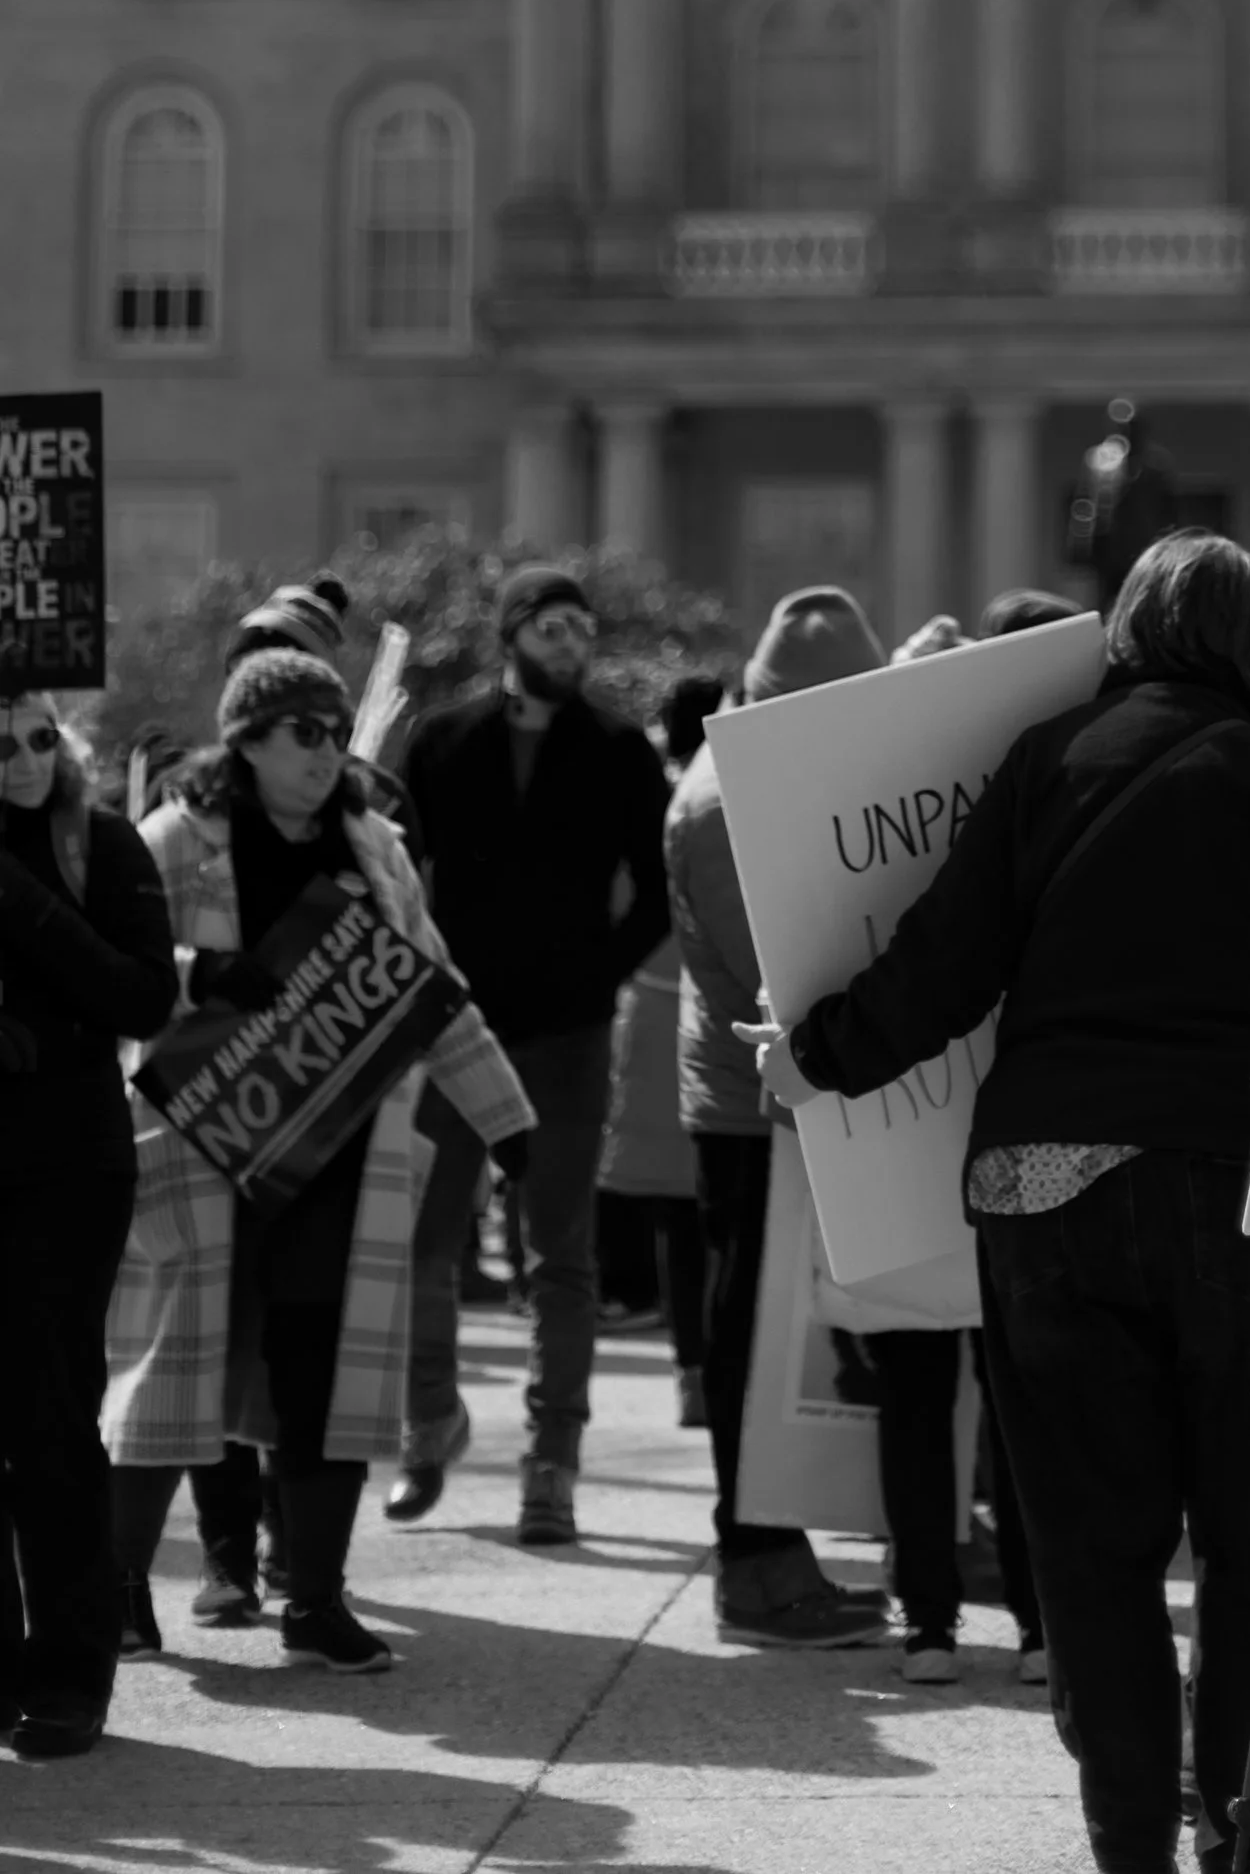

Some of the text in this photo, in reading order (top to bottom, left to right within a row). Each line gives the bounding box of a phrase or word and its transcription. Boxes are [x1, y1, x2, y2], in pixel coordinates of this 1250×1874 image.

[0, 489, 93, 538] PLE
[833, 774, 990, 873] UNPA
[165, 1064, 220, 1130] NEW
[320, 898, 375, 962] SAYS
[195, 925, 416, 1169] NO KINGS
